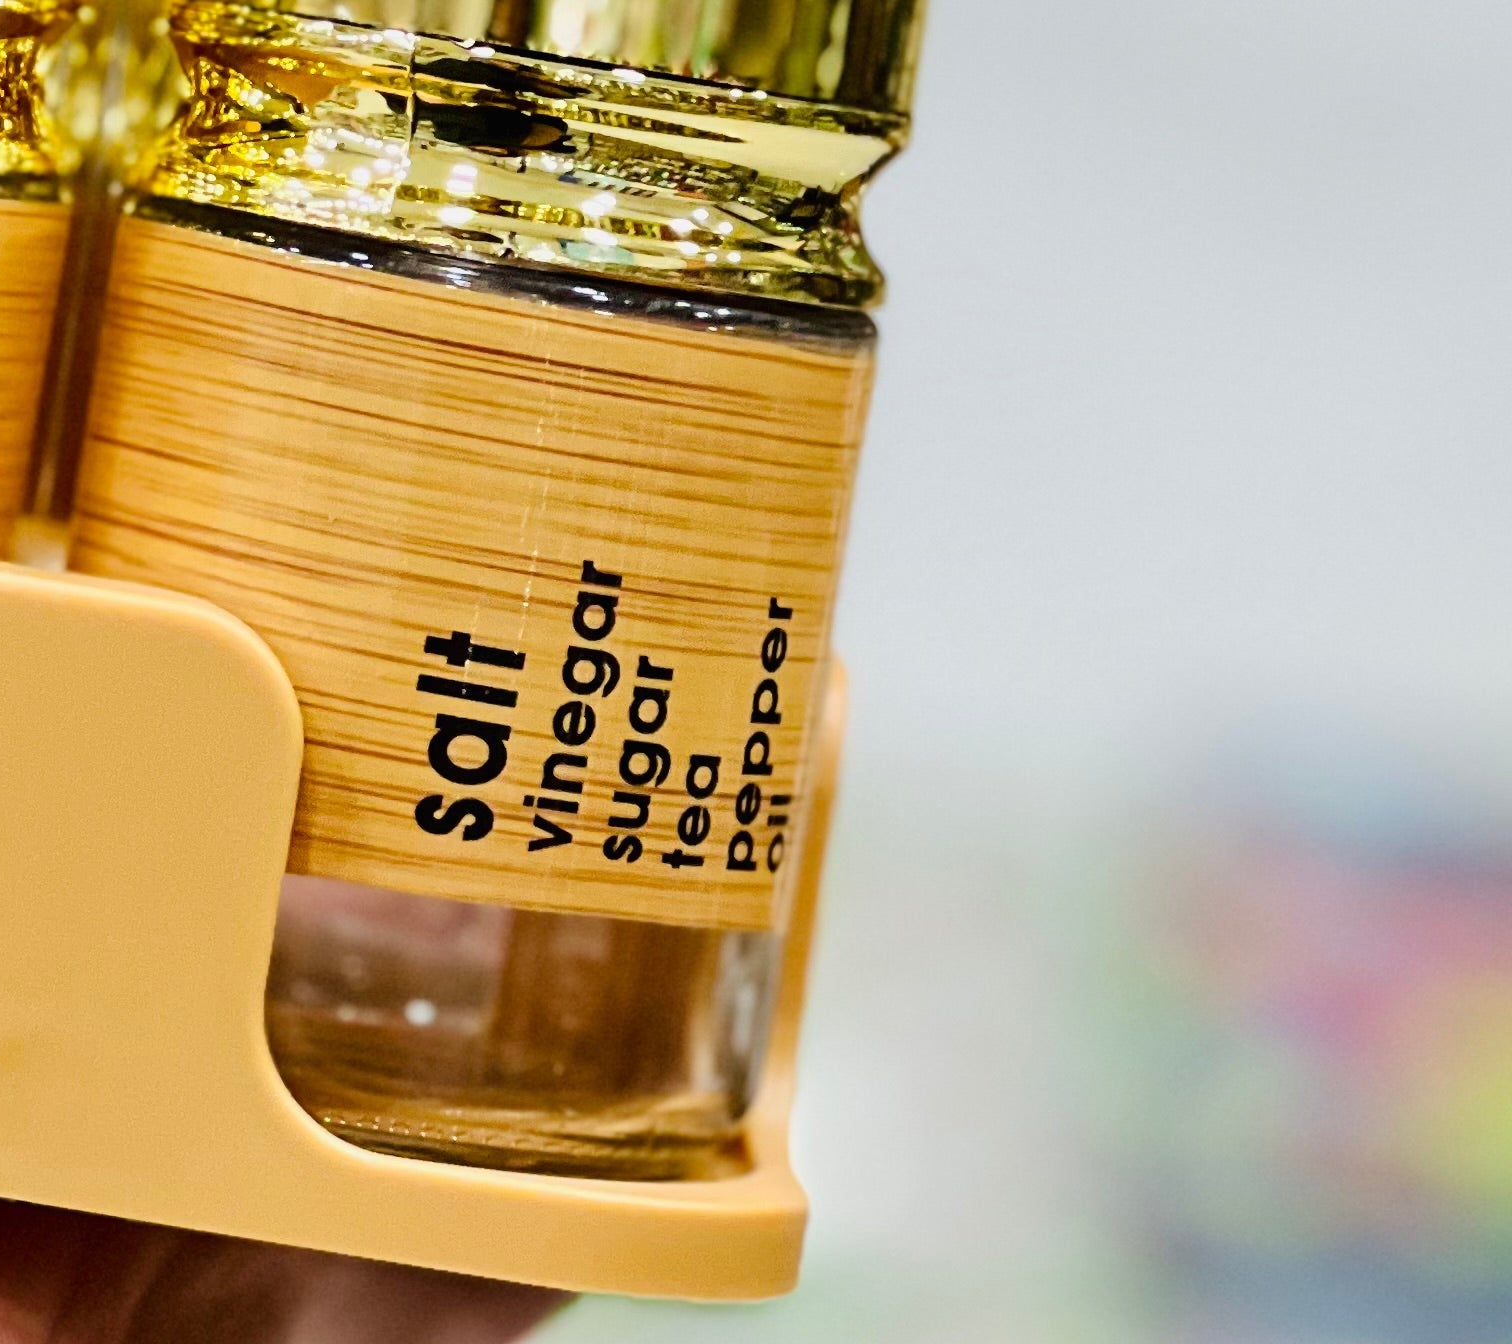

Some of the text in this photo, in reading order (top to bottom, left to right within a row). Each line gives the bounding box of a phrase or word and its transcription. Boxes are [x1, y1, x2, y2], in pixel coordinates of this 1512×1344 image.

[414, 631, 526, 841] salt
[523, 560, 622, 851] vinegar
[603, 655, 674, 863] sugar
[727, 597, 793, 871] pepper
[662, 754, 720, 869] tea
